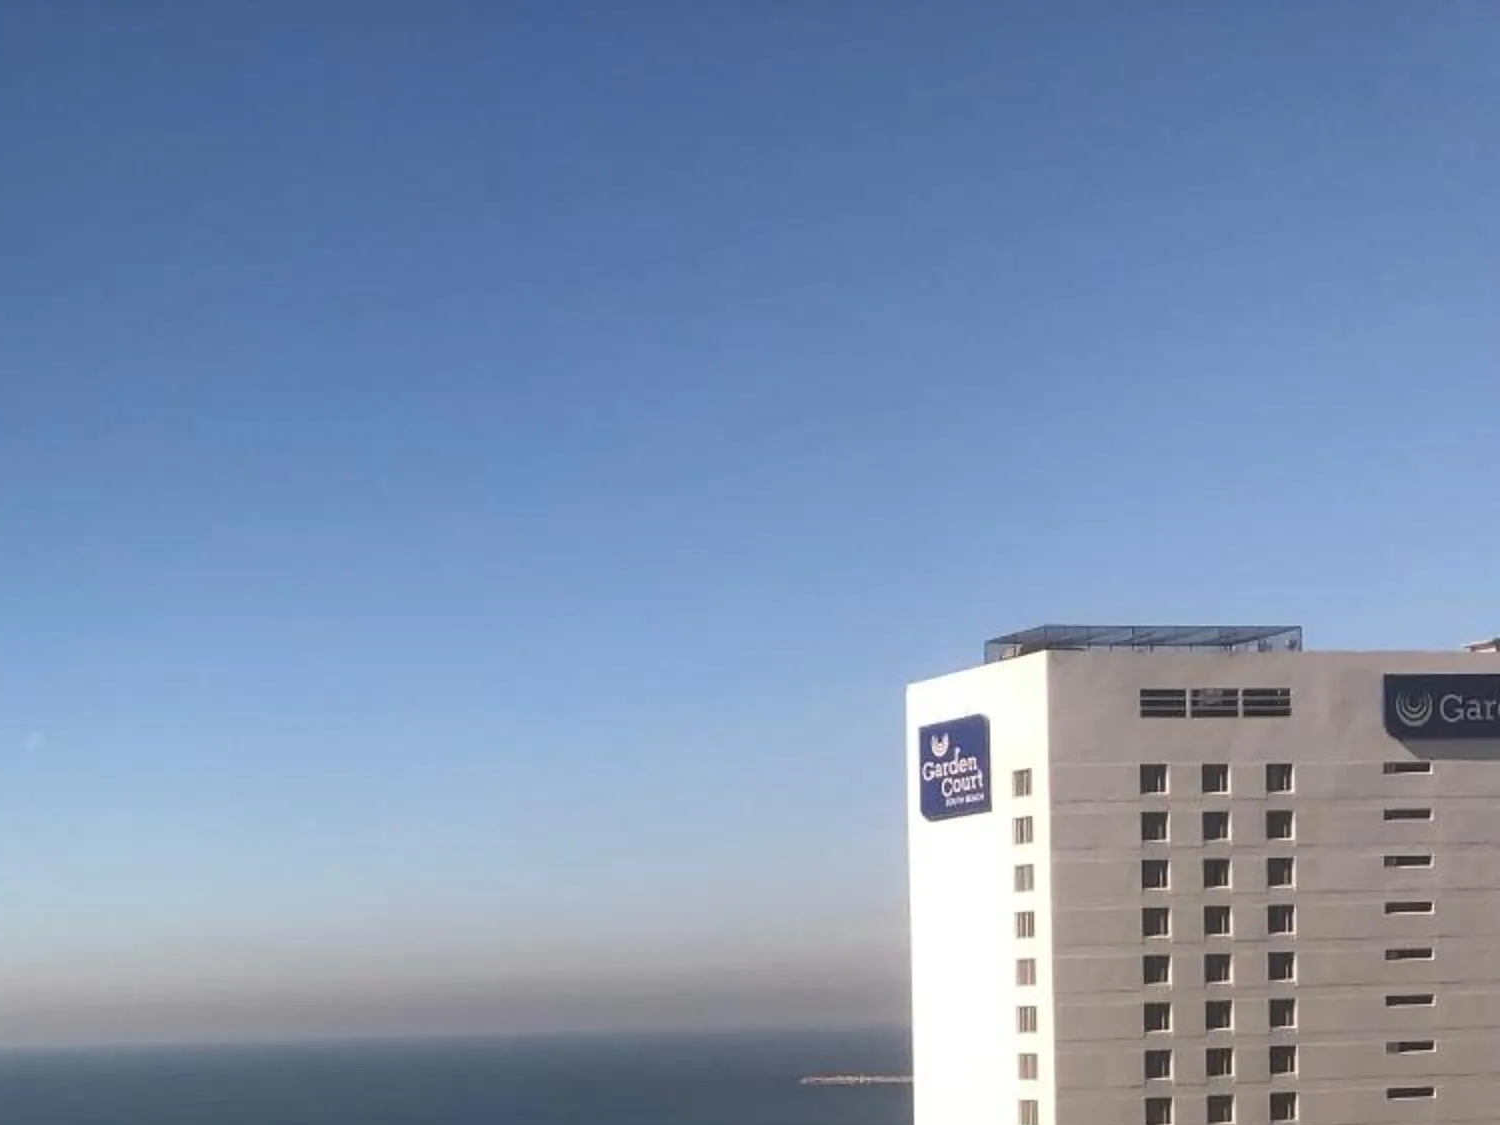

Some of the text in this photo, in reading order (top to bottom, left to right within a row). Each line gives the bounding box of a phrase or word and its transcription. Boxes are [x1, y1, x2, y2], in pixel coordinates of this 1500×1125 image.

[1440, 693, 1500, 723] Gar
[922, 746, 978, 781] Garden
[941, 769, 984, 797] Court
